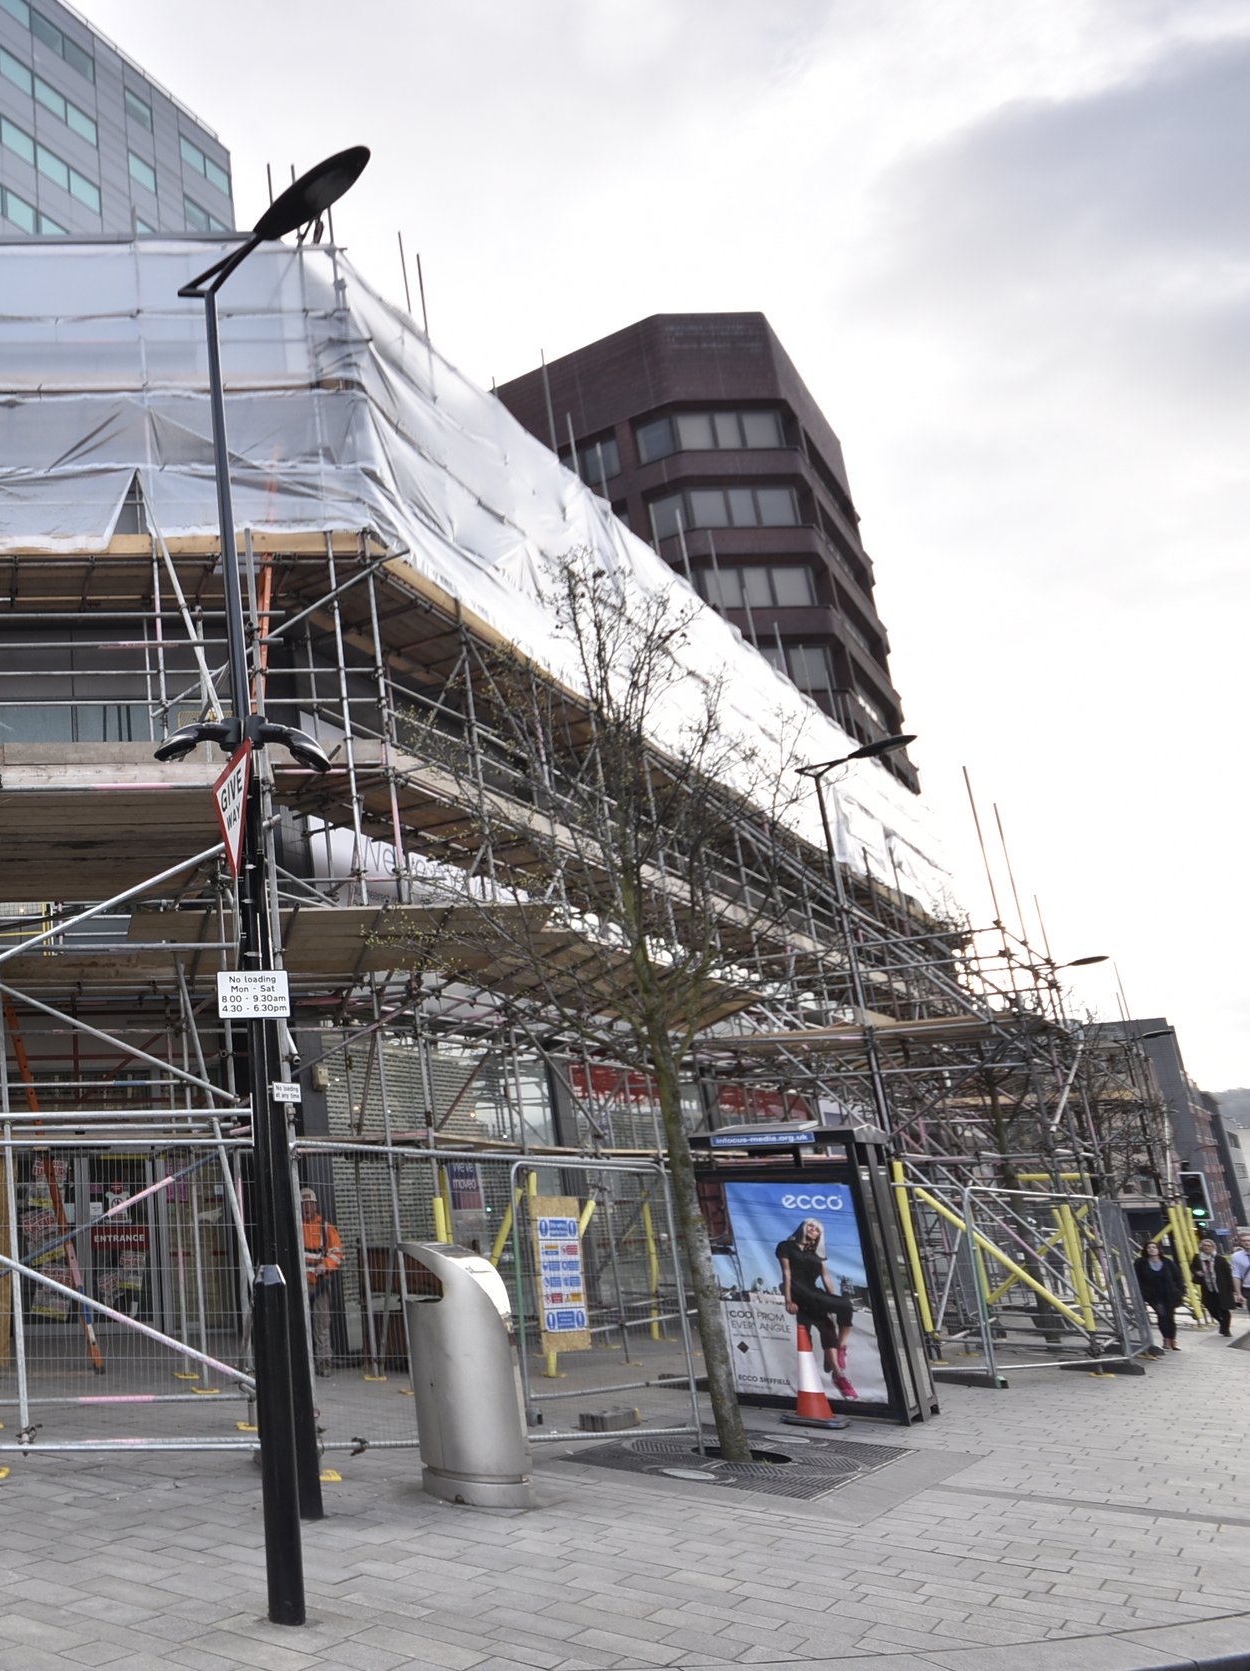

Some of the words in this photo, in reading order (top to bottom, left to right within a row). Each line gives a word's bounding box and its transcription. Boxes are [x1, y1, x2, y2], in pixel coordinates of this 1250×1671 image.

[221, 768, 242, 813] GIVE
[226, 802, 241, 831] WAY
[245, 976, 276, 984] loading
[231, 985, 249, 993] Mon
[221, 995, 242, 1003] 8.00
[253, 994, 286, 1003] 9.30am
[222, 1004, 243, 1012] 4.30
[253, 1004, 287, 1012] 6.30pm
[283, 1085, 298, 1093] loading
[715, 1134, 809, 1145] infocus-media.org.uk
[781, 1194, 843, 1211] ecco
[93, 1234, 145, 1243] ENTRANCE
[759, 1322, 792, 1334] ANGLE
[738, 1374, 758, 1383] ECCO
